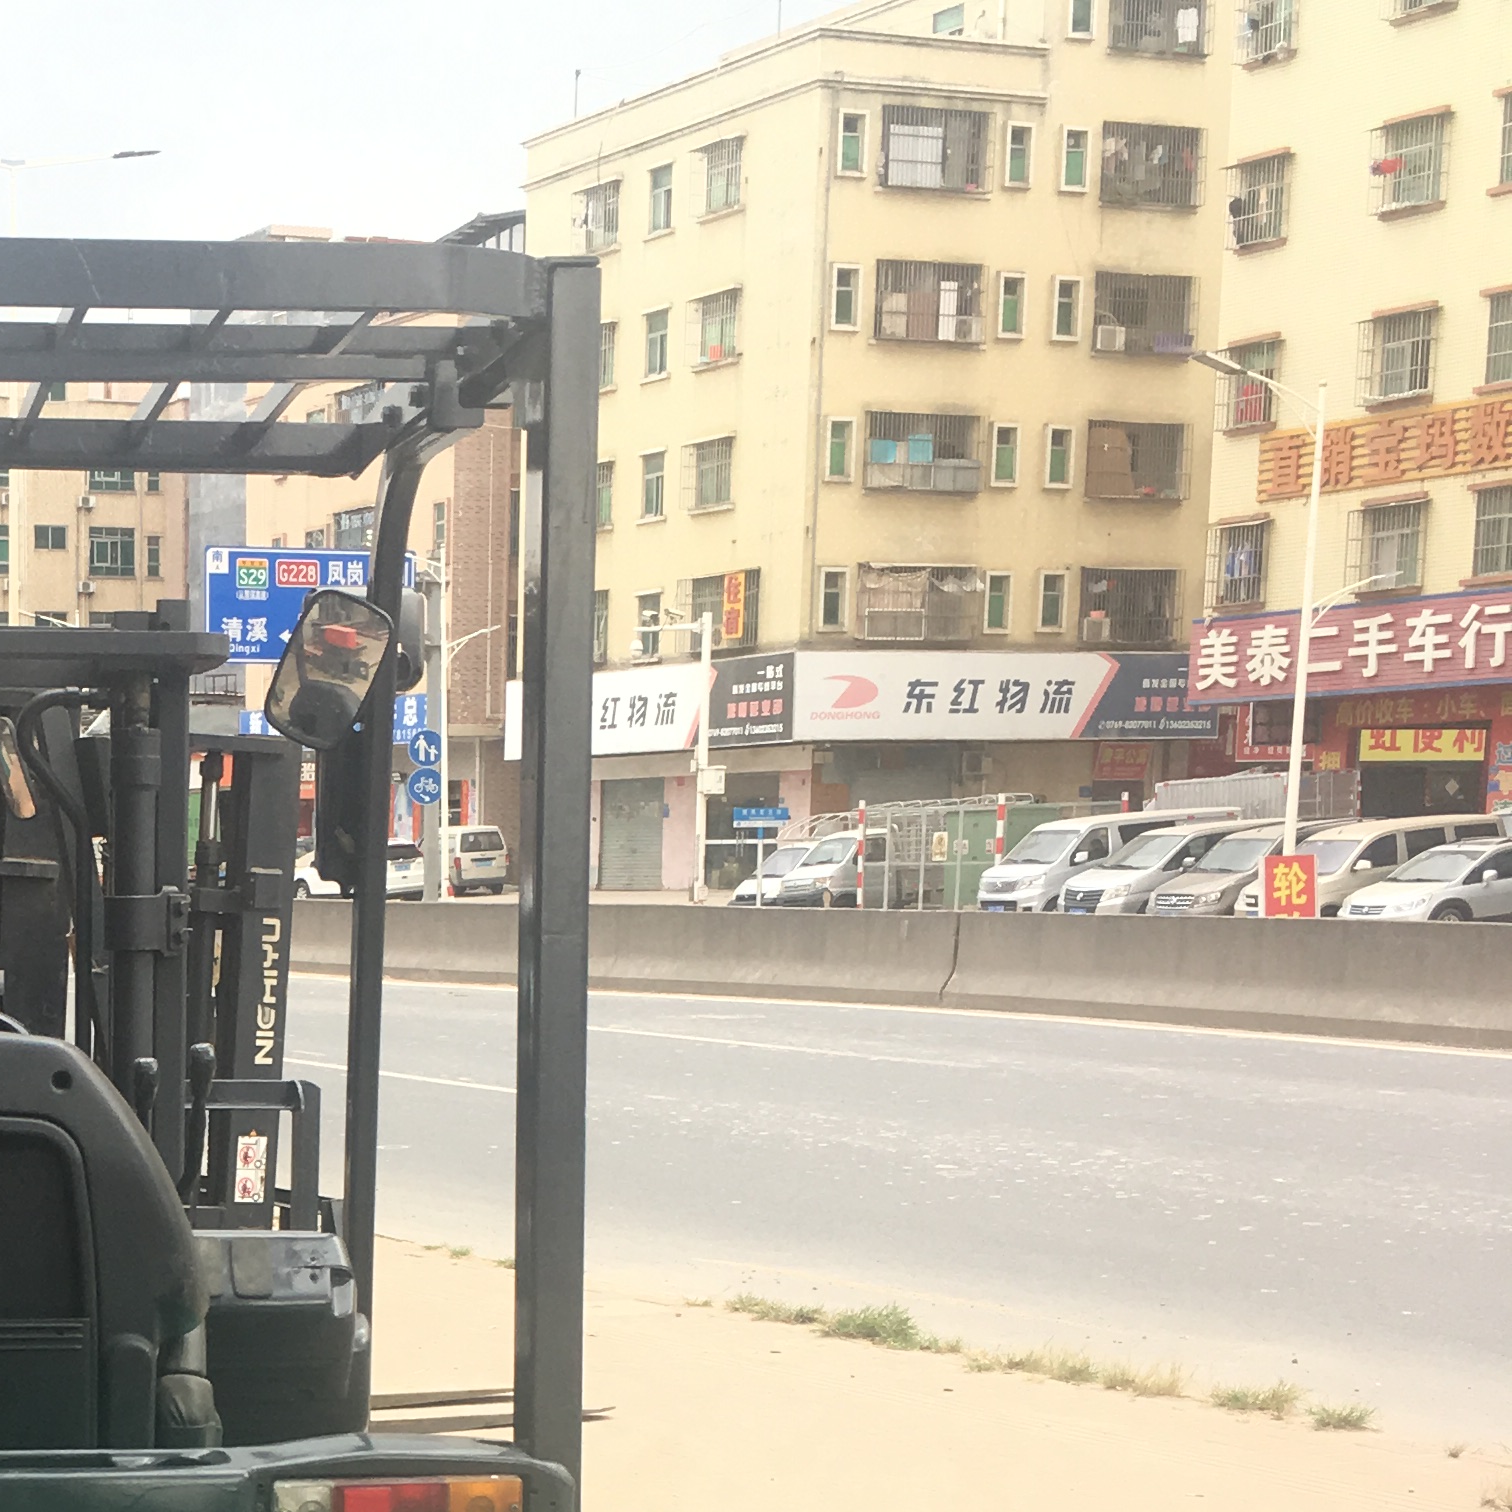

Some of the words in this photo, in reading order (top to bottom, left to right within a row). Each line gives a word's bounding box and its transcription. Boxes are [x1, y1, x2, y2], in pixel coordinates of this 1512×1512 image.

[212, 550, 223, 563] 南
[240, 569, 266, 585] S29
[279, 566, 317, 583] G228
[327, 560, 364, 586] 凤岗
[221, 617, 268, 643] 清溪
[1195, 603, 1512, 691] 美泰二手车行
[902, 678, 1075, 714] 东红物流
[599, 691, 678, 730] 红物流
[810, 711, 880, 720] DONGHONG
